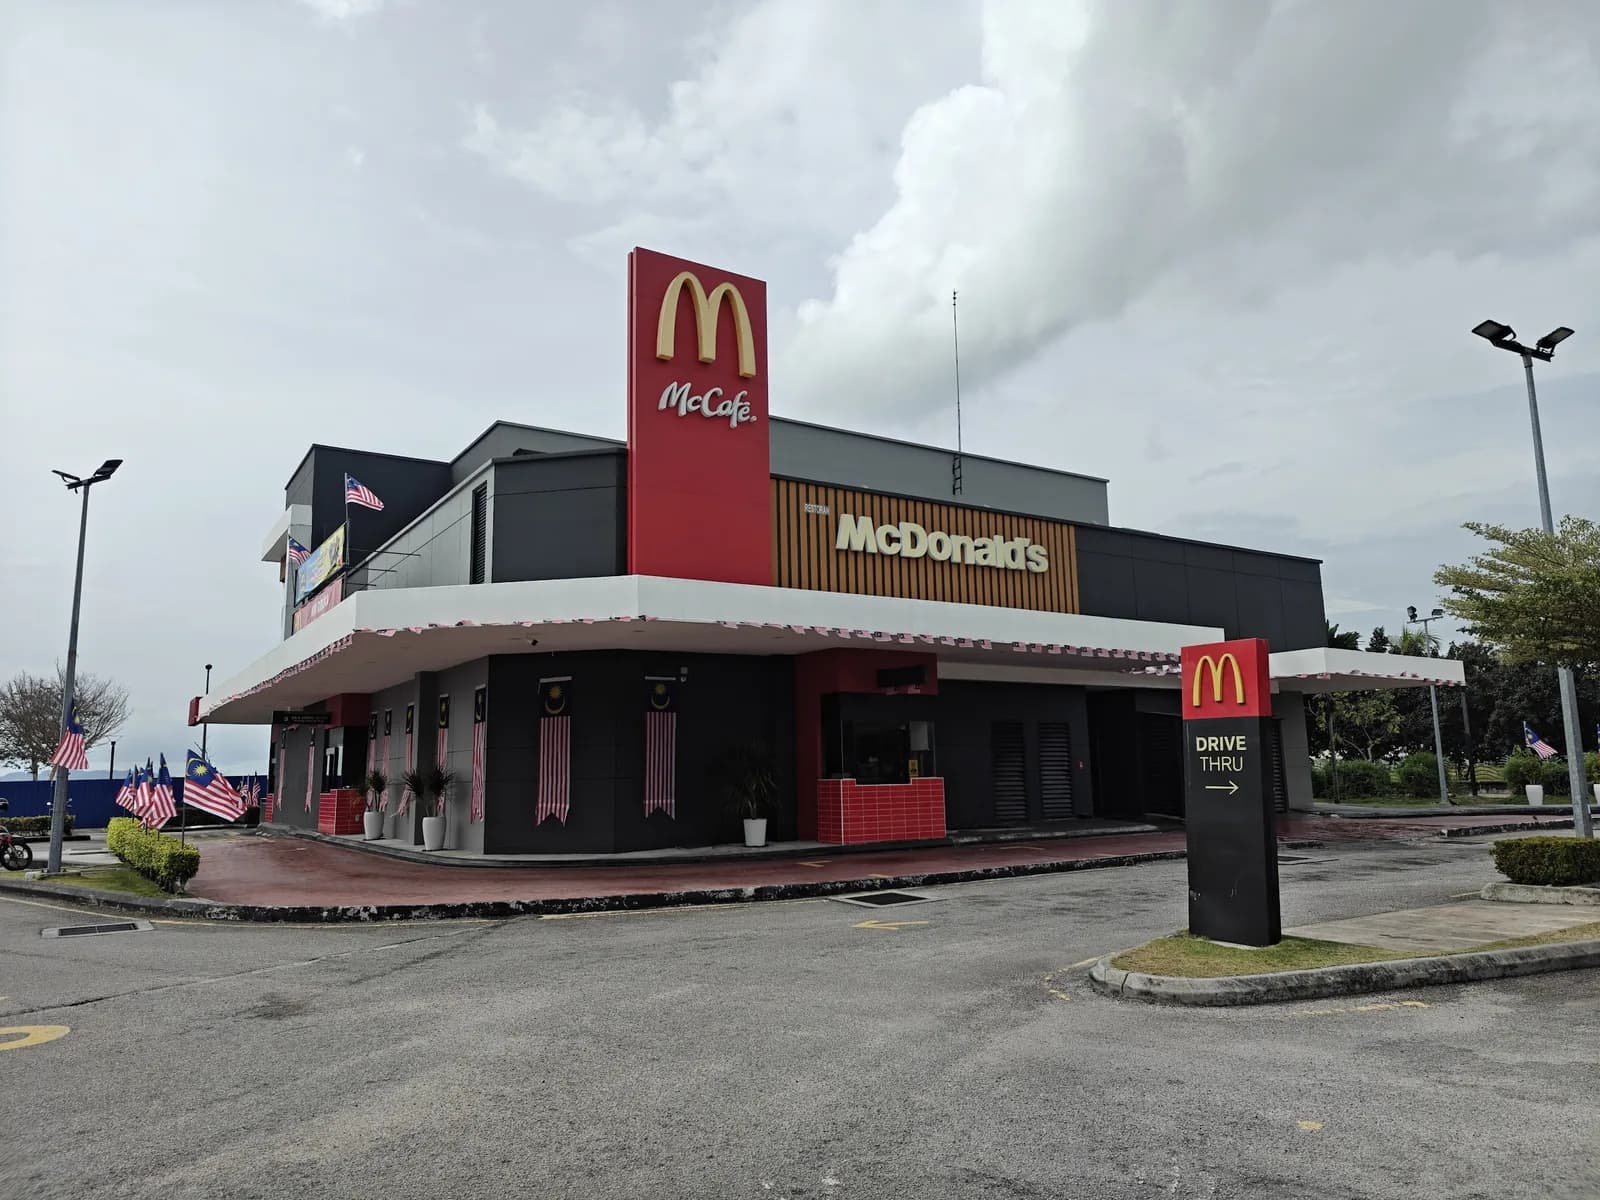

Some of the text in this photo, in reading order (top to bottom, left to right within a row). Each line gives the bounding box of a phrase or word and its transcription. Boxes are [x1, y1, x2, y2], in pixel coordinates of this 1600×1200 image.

[836, 513, 1049, 573] McDonald's
[1195, 735, 1247, 752] DRIVE
[1199, 756, 1244, 772] THRU
